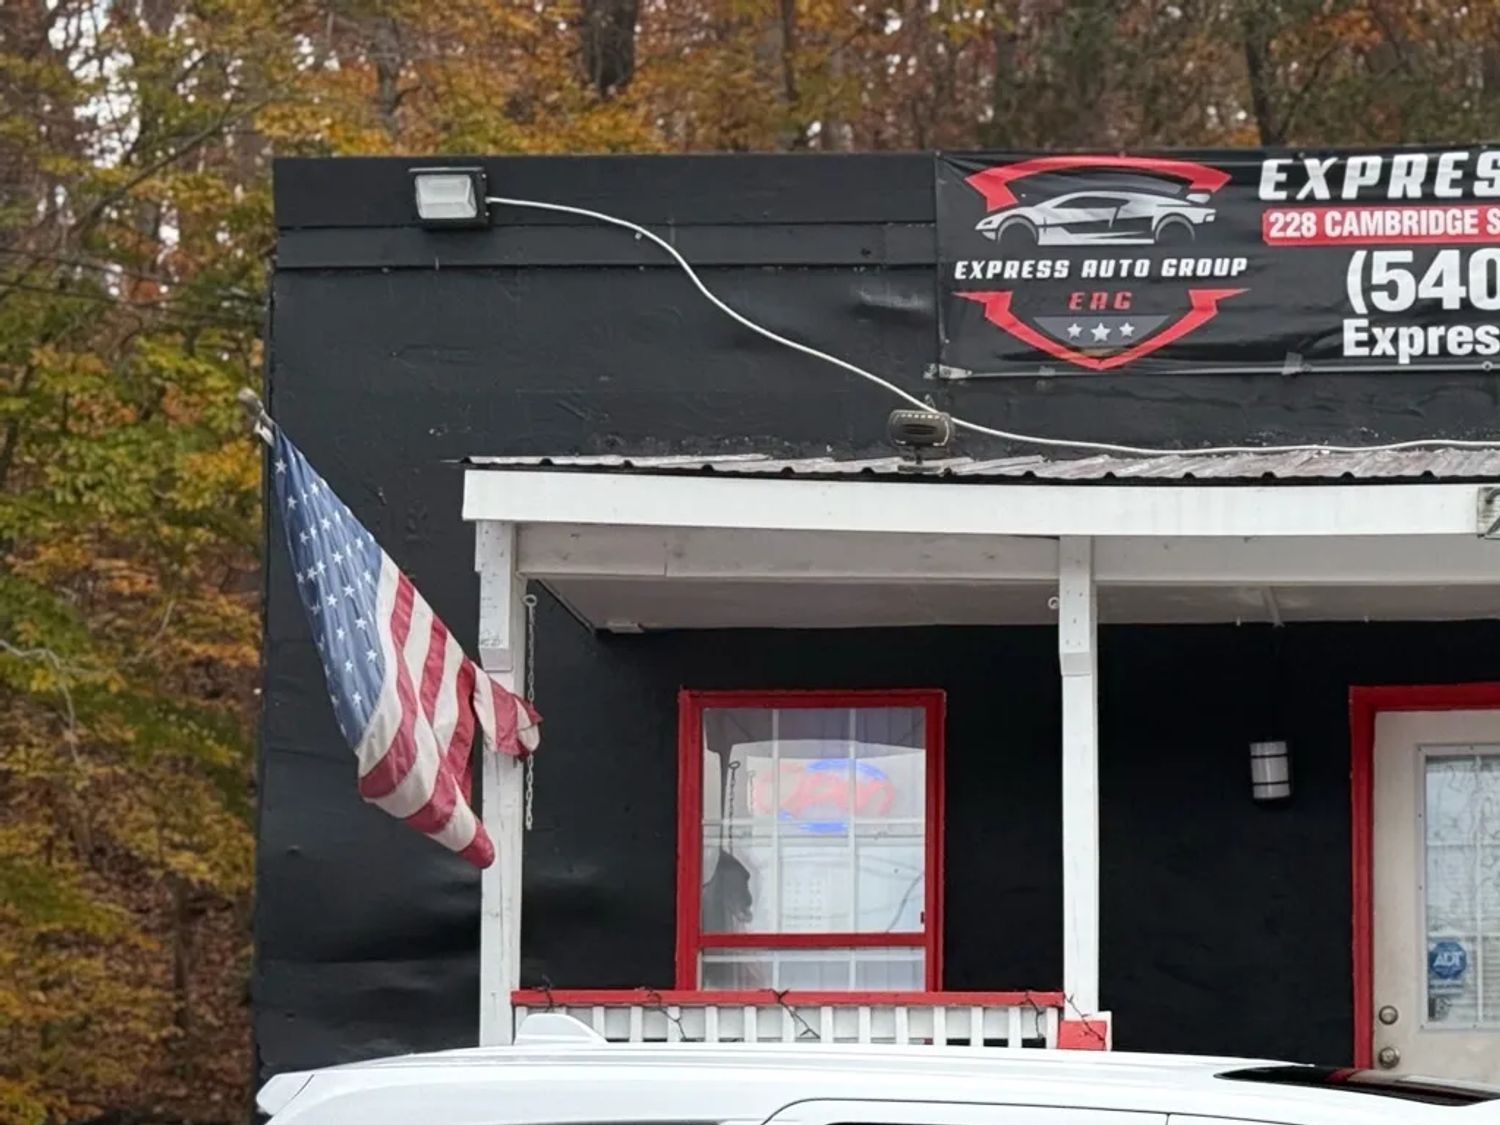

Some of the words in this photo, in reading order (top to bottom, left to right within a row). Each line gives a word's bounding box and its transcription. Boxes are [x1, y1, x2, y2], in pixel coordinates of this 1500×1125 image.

[1269, 212, 1317, 238] 228
[1325, 206, 1479, 237] CAMBRIDGE
[954, 259, 1070, 280] EXPRESS
[1081, 258, 1152, 279] AUTO
[1160, 257, 1249, 278] GROUP
[1068, 291, 1133, 311] EAG
[1433, 952, 1463, 967] ADT
